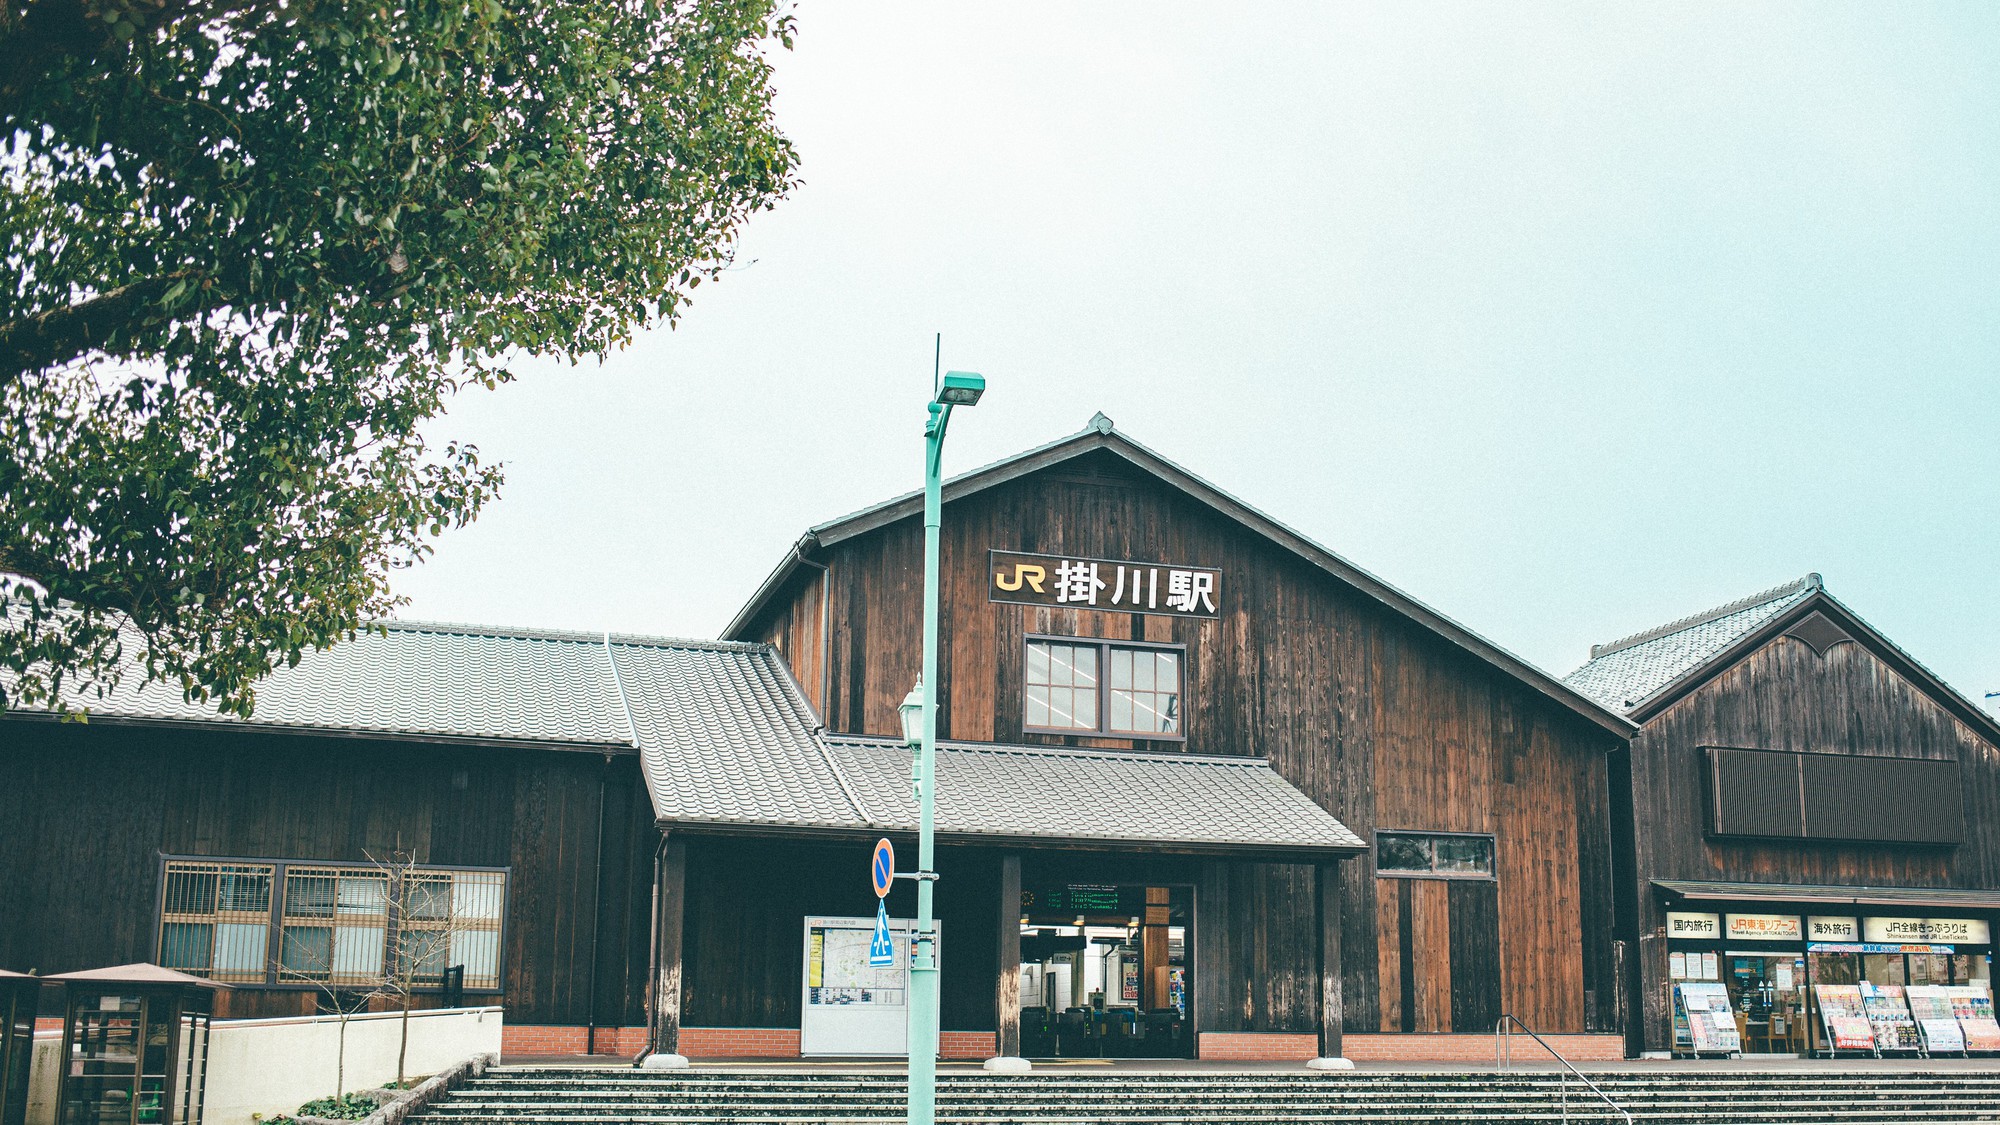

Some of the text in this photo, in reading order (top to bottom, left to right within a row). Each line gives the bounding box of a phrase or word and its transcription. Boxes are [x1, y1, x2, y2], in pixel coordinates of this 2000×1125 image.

[995, 559, 1216, 614] JR 掛川駅
[1673, 919, 1714, 932] 国内旅行
[1731, 919, 1798, 931] JR東海ツアーズ
[1813, 922, 1852, 935] 海外旅行
[1885, 922, 1968, 934] JR全線きっぷうりば
